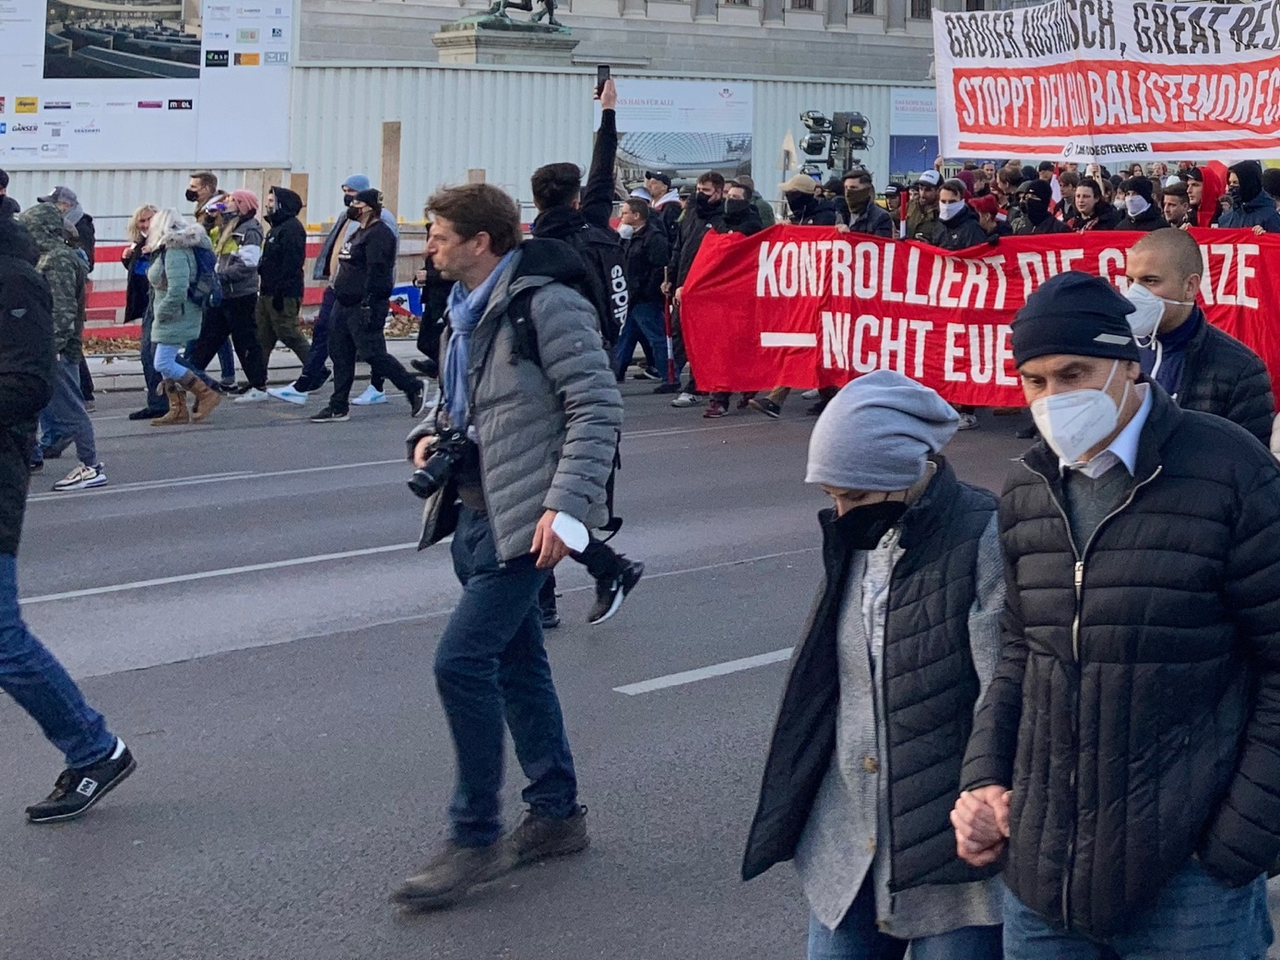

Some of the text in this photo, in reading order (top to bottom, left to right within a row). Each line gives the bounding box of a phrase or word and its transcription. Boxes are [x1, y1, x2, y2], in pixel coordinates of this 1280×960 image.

[1133, 2, 1232, 55] GREAT
[958, 76, 1035, 128] STOPPT
[756, 240, 1007, 309] KONTROLLIERT
[821, 311, 933, 378] NICHT
